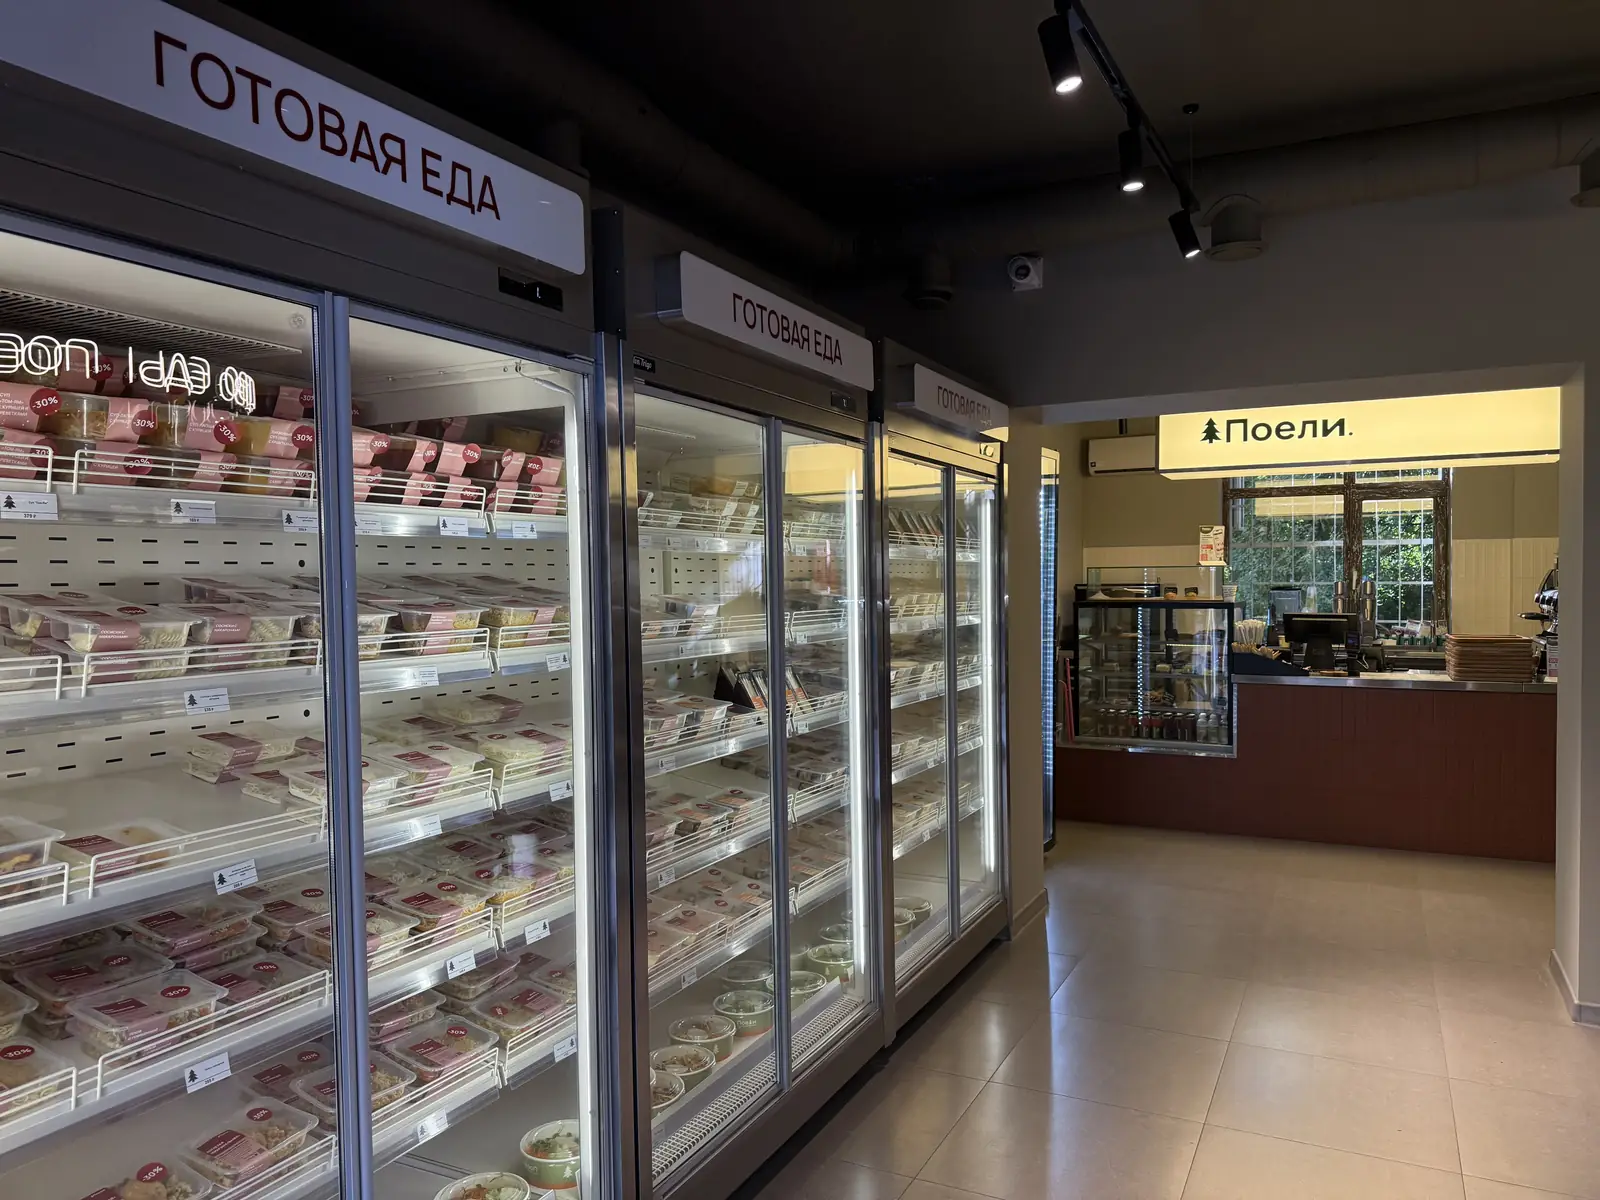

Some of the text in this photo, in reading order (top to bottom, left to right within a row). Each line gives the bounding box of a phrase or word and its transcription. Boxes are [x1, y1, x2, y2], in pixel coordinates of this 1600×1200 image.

[153, 30, 501, 221] ГОТОВАЯ ЕДА
[731, 292, 843, 367] ГОТОВАЯ ЕДА
[32, 396, 58, 409] -30%
[936, 385, 976, 420] ГОТОВАЯ
[133, 419, 156, 428] -30%
[1225, 417, 1354, 443] Поели.
[218, 424, 237, 442] -30%
[293, 434, 313, 442] -30%
[371, 440, 388, 448] -30%
[464, 449, 480, 460] -30%
[163, 986, 189, 998] -30%
[3, 1047, 32, 1059] -30%
[142, 1166, 163, 1181] -30%
